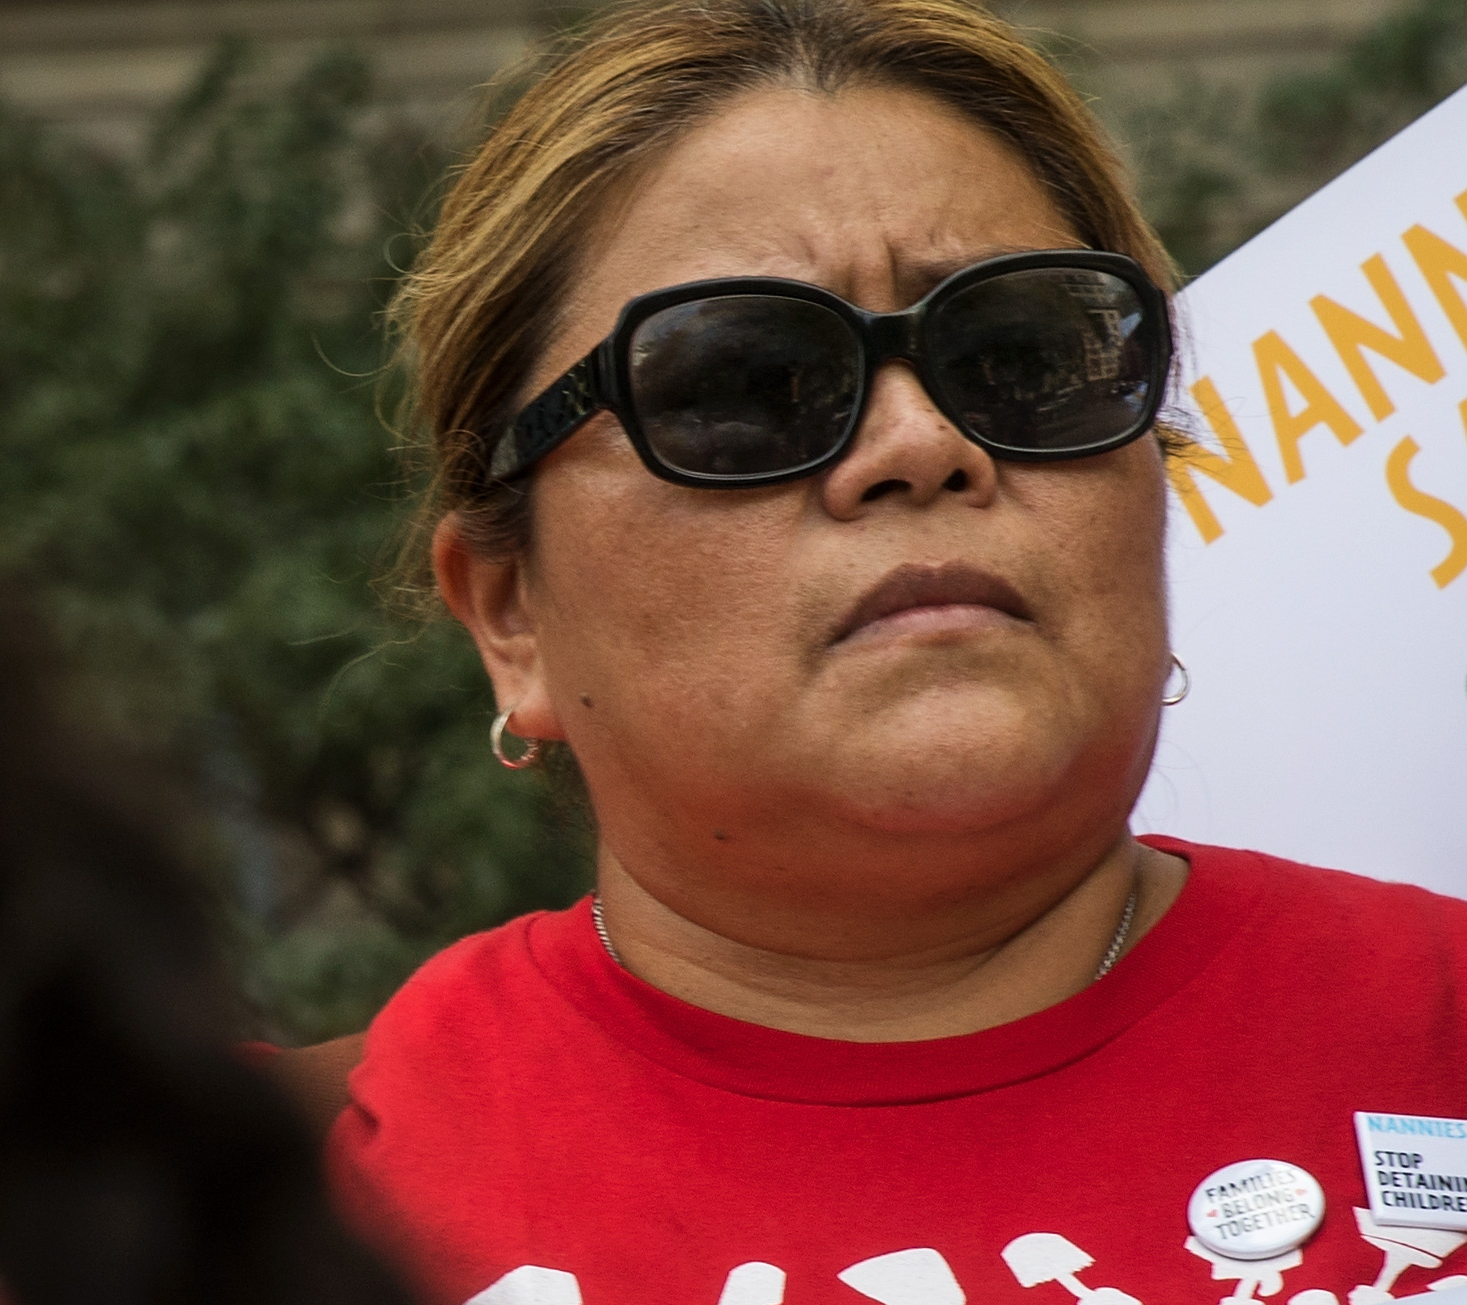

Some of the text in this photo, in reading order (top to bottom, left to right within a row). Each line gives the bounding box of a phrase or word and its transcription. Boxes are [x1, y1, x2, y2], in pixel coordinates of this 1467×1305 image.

[1367, 1116, 1467, 1140] NANNIES
[1375, 1150, 1424, 1170] STOP
[1205, 1170, 1297, 1204] FAMILIES
[1221, 1188, 1295, 1219] BELONG
[1215, 1204, 1316, 1240] TOGETHER
